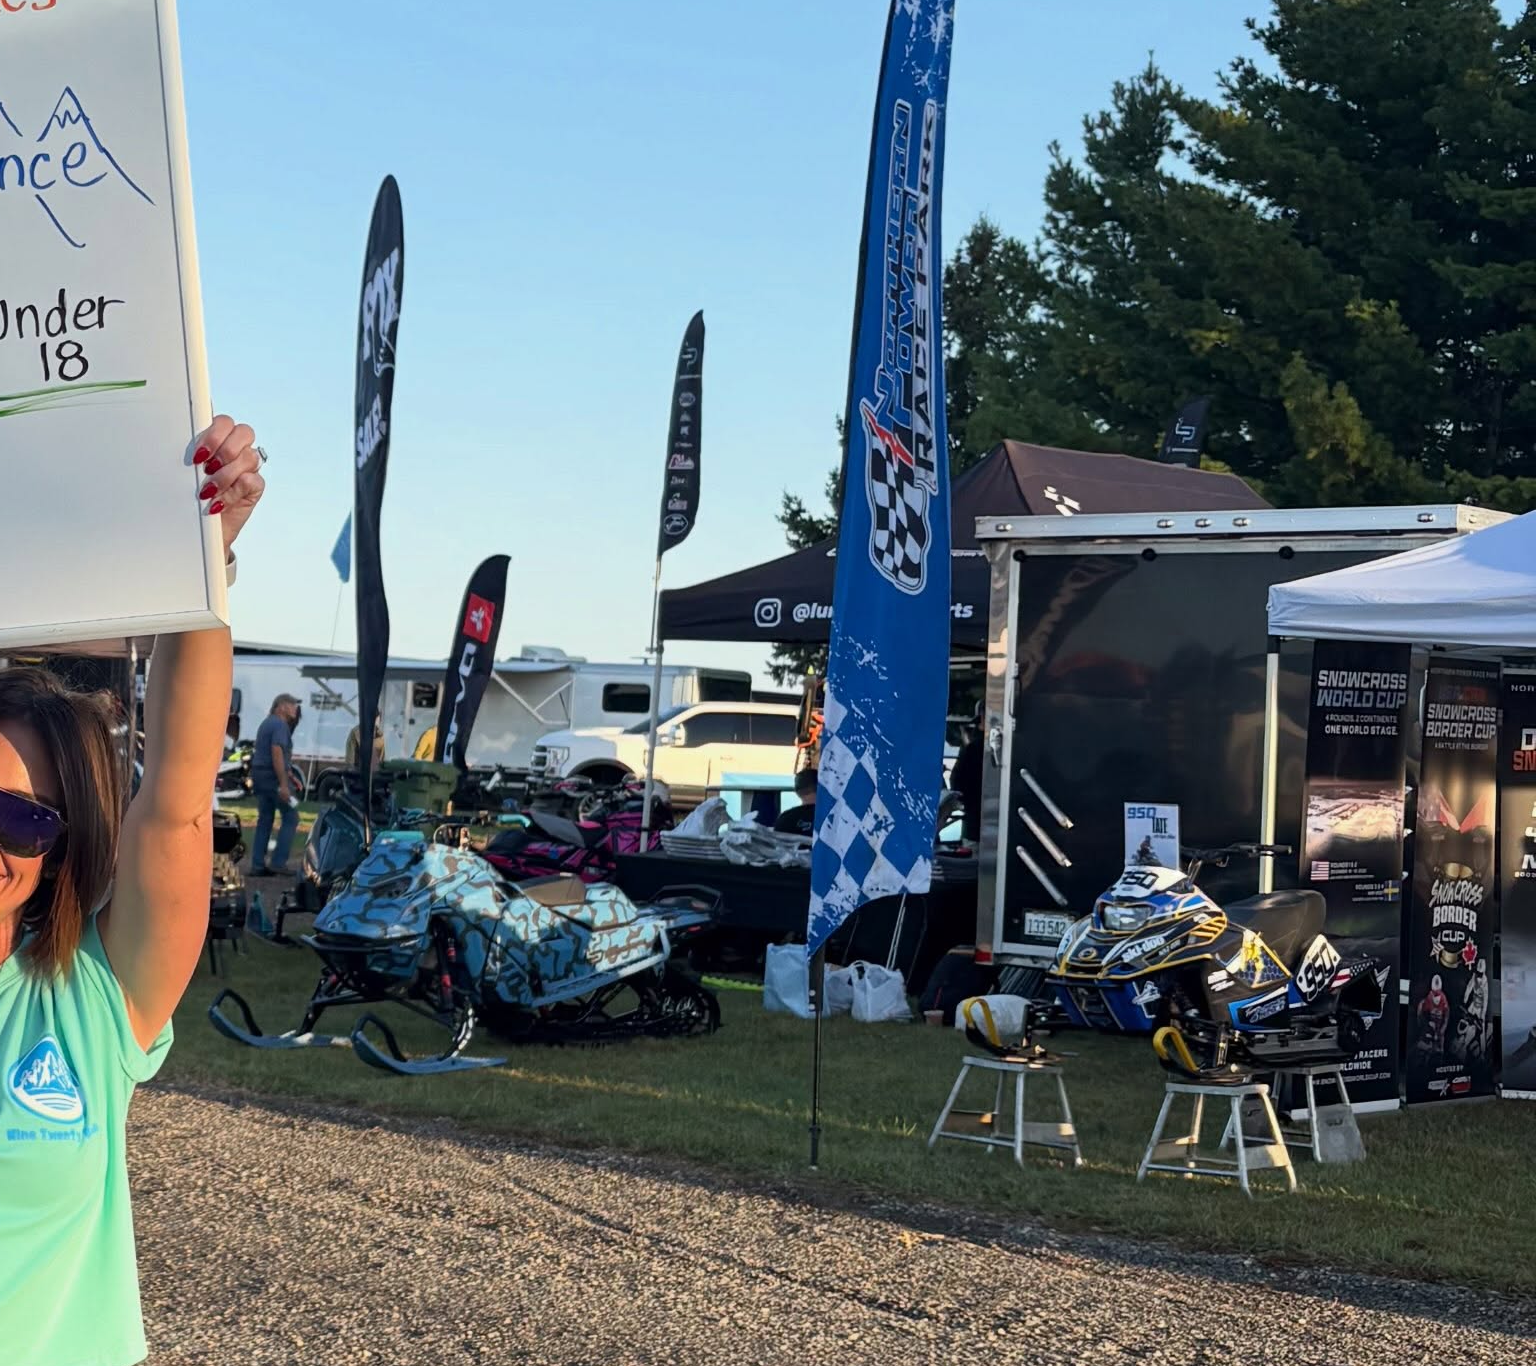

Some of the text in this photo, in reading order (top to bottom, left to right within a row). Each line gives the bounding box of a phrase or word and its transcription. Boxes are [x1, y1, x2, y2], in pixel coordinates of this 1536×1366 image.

[865, 100, 912, 432] NORTHERN
[888, 192, 919, 430] POWER
[38, 340, 91, 382] 18
[1317, 669, 1407, 689] SNOWCROSS
[1316, 689, 1407, 709] WORLD CUP
[1427, 703, 1496, 722] SNOWCROSS
[1325, 725, 1341, 734] ONE
[1342, 725, 1369, 734] WORLD
[1425, 721, 1497, 739] BORDER CUP
[1127, 806, 1157, 819] 950
[1152, 817, 1168, 833] TATE
[1432, 905, 1477, 932] BORDER
[1441, 929, 1466, 943] CUP
